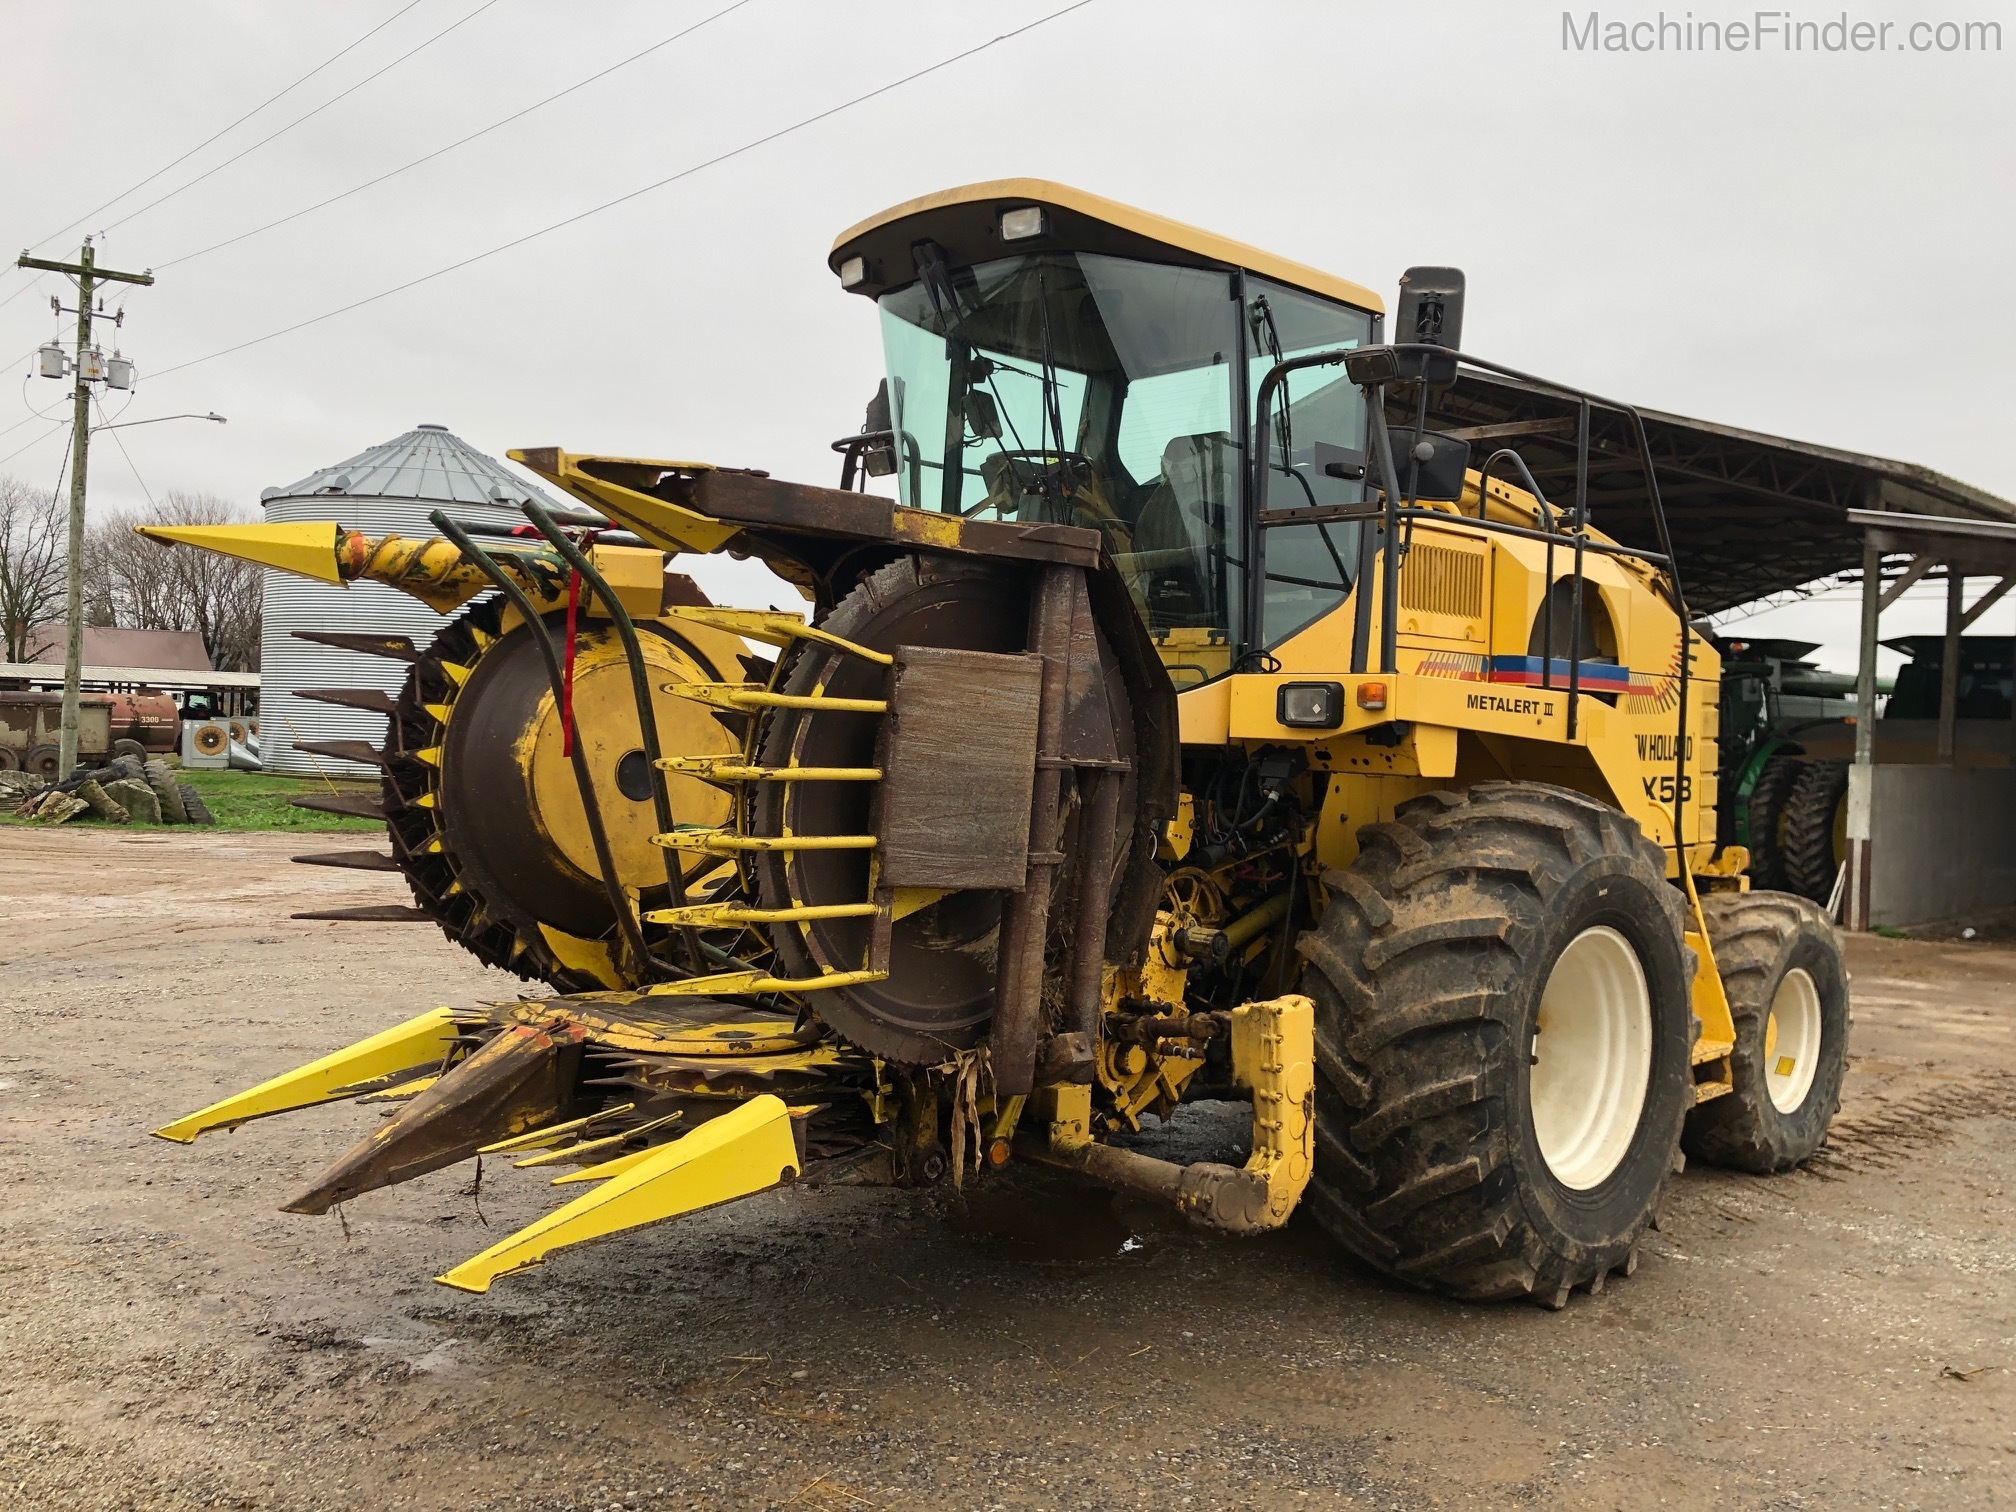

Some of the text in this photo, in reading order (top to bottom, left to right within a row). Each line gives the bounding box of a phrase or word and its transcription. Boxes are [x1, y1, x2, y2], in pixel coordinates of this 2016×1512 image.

[1467, 694, 1554, 716] METALERT III
[141, 716, 159, 724] 3300
[1649, 733, 1692, 761] HOLLAD
